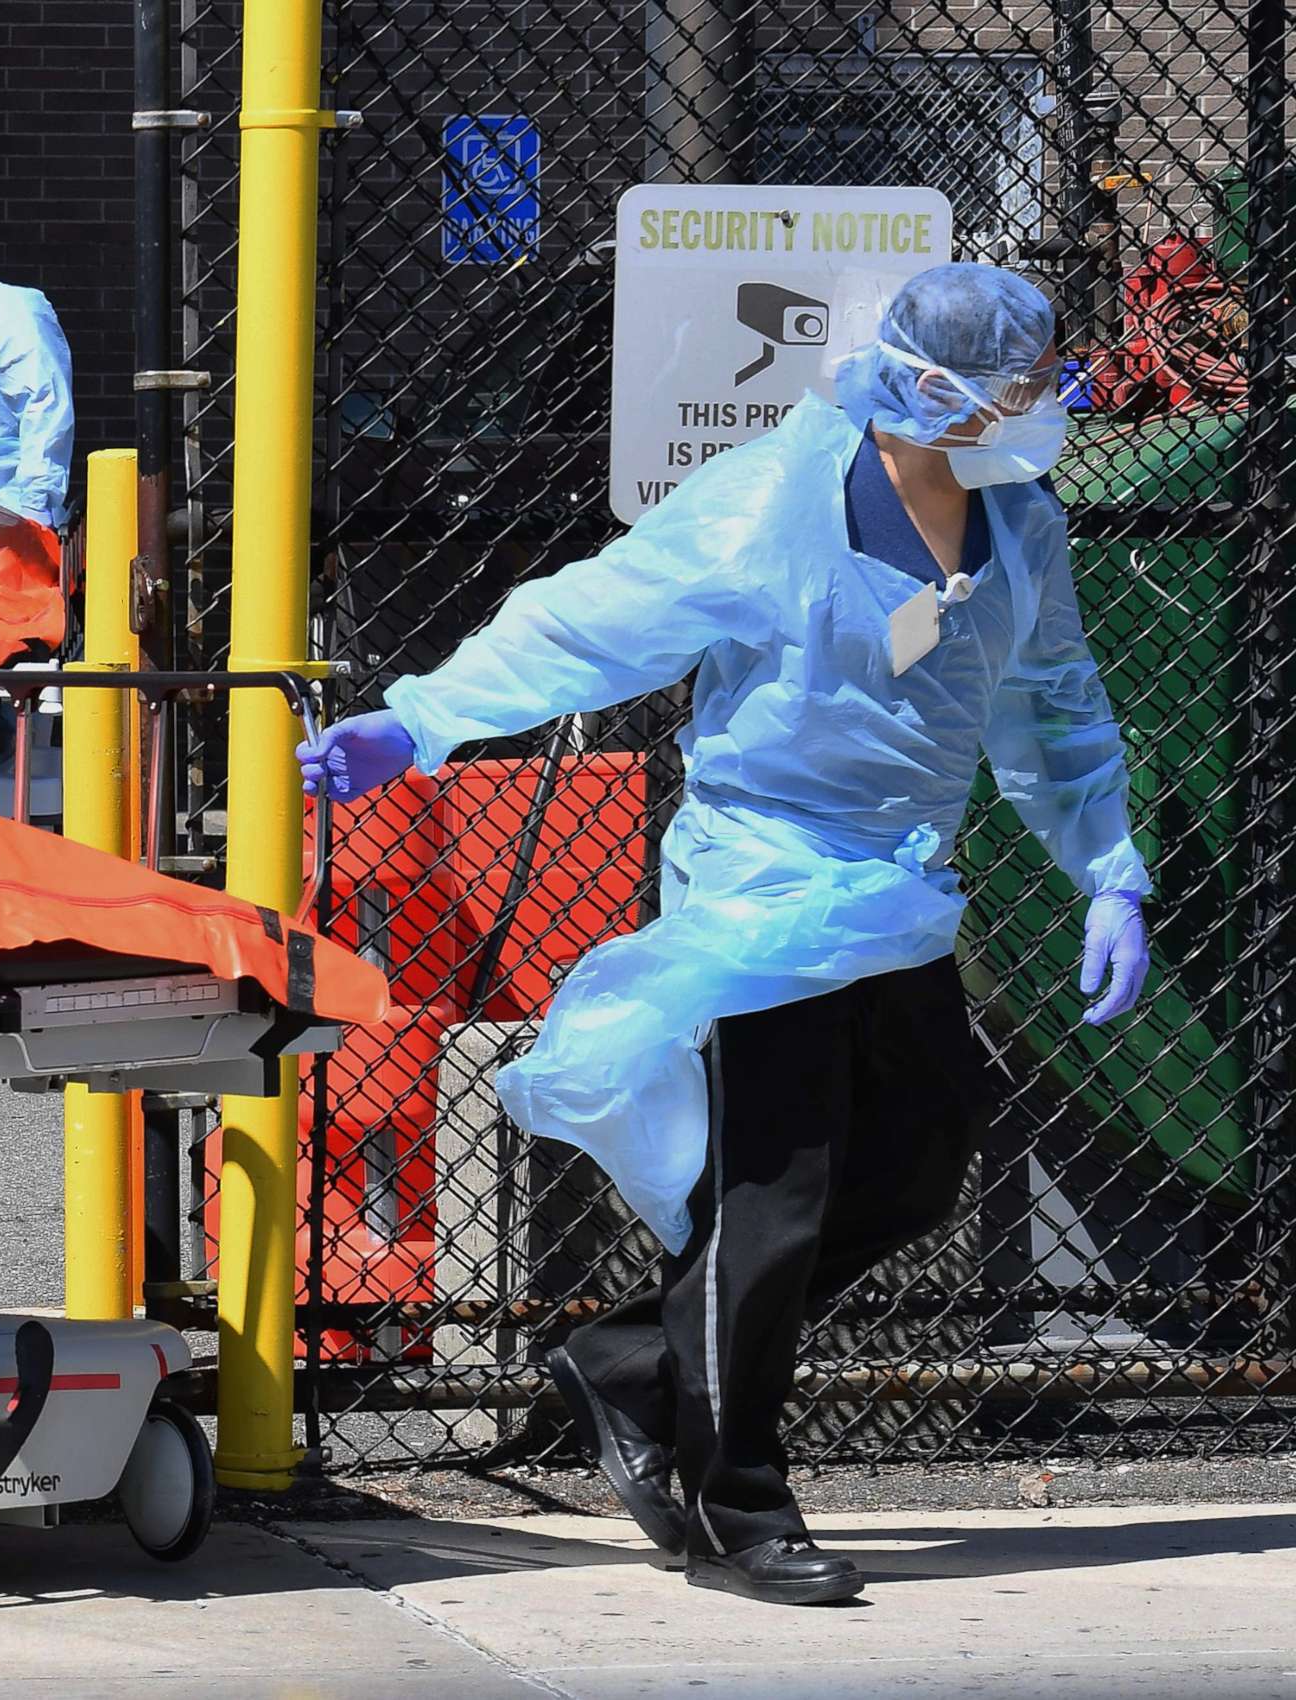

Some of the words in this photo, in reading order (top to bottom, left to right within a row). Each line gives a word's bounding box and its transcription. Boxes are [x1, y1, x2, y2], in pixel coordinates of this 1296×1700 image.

[640, 209, 800, 251] SECURITY
[812, 212, 932, 253] NOTICE
[678, 403, 737, 427] THIS
[667, 442, 693, 466] IS
